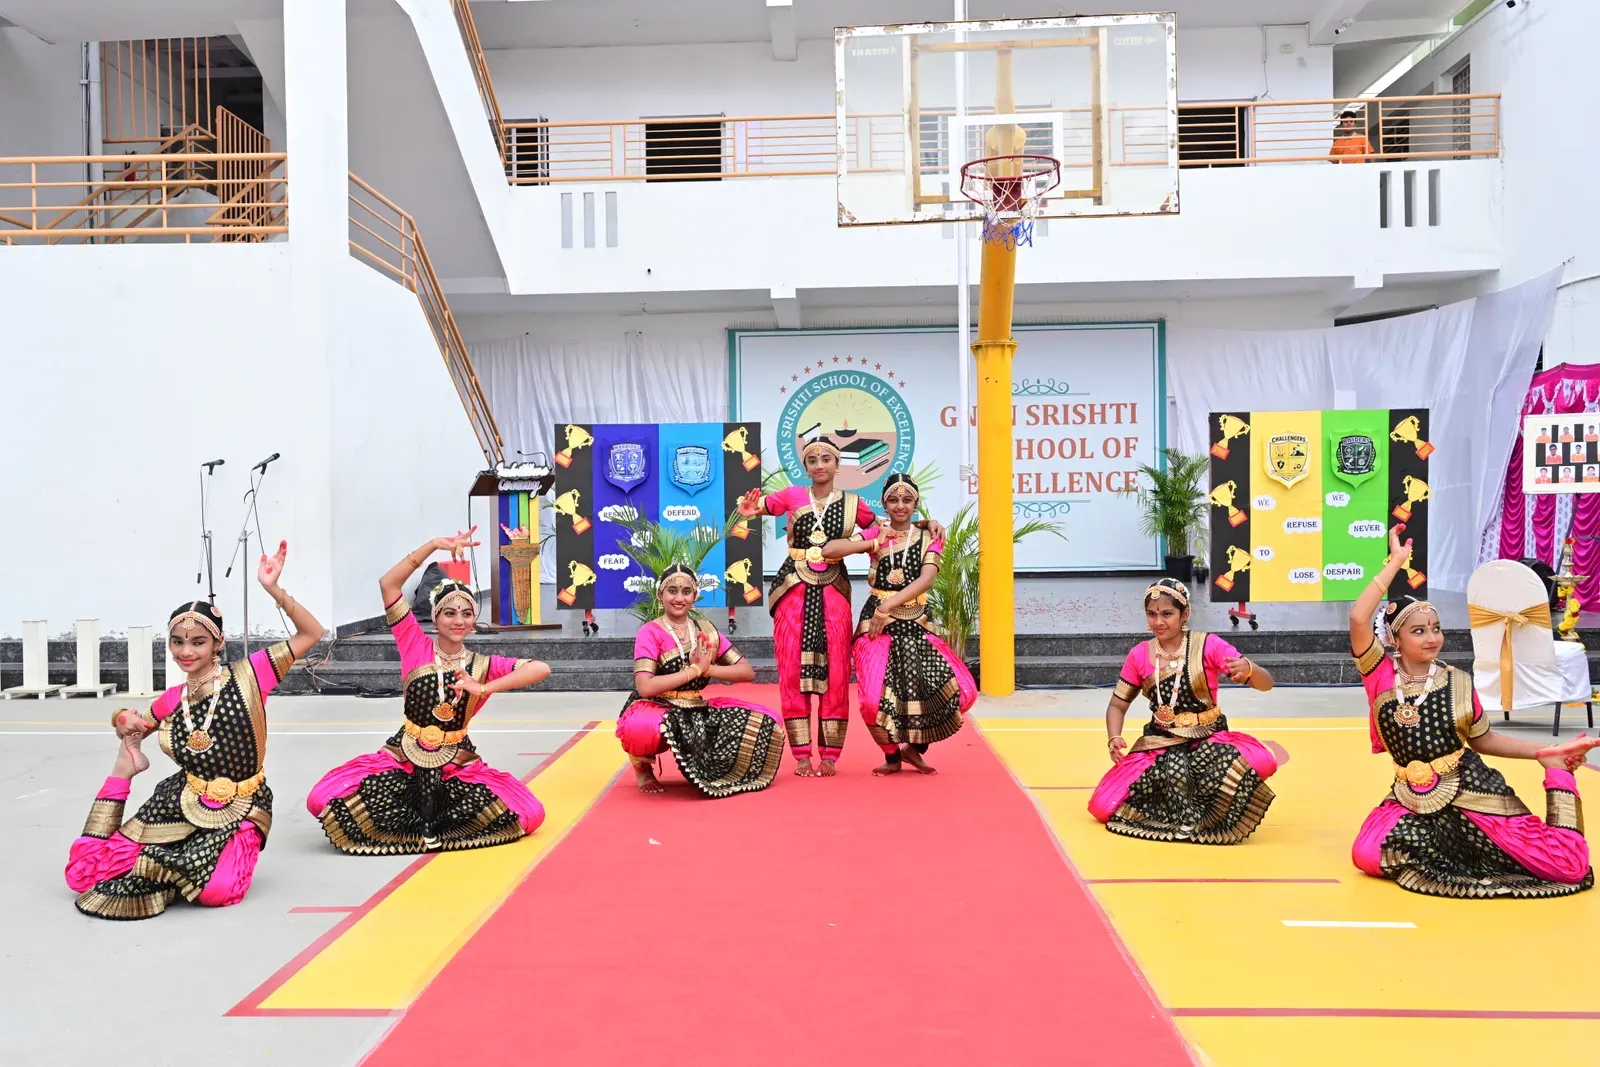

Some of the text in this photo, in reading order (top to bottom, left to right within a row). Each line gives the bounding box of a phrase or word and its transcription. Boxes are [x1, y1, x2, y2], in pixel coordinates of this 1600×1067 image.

[812, 374, 868, 393] SCHOOL
[870, 381, 890, 398] OF
[781, 388, 813, 439] SRISHTI
[1025, 402, 1139, 427] SRISHTI
[1271, 434, 1306, 443] CHALLENGERS
[1014, 436, 1139, 460] HOOL OF
[781, 442, 802, 479] GNAN
[968, 470, 1139, 495] EELLENCE
[1258, 499, 1270, 507] WE
[667, 509, 697, 517] DEFEND
[1286, 521, 1318, 529] REFUSE
[1353, 524, 1381, 532] NEVER
[1294, 571, 1315, 579] LOSE
[1326, 568, 1361, 576] DESPAIR
